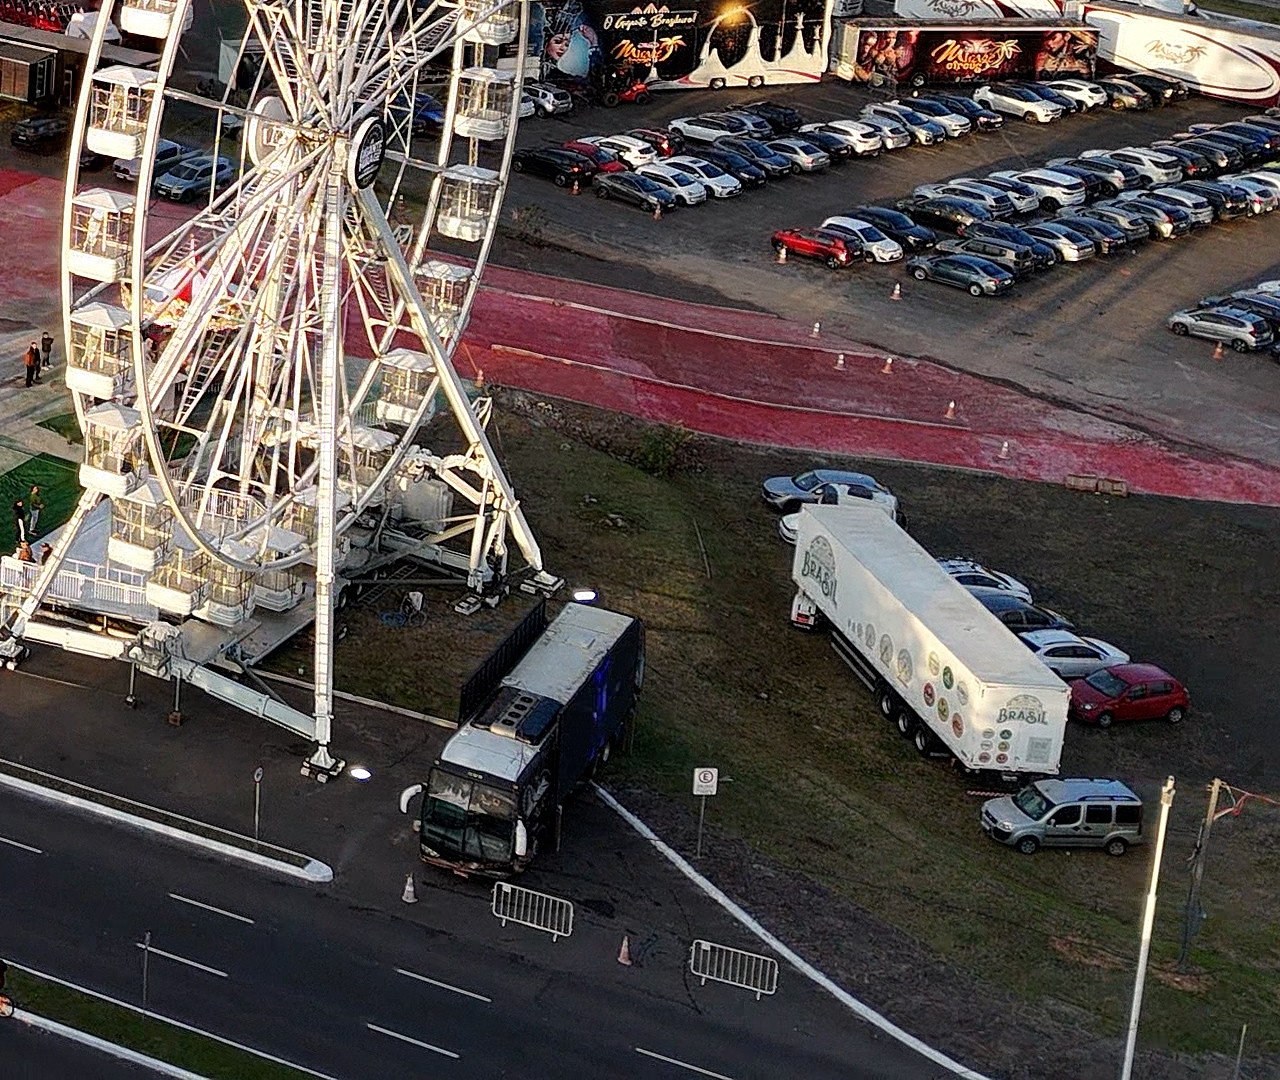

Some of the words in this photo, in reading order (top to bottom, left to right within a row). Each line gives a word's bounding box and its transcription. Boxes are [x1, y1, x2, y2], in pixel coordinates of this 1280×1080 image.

[930, 39, 998, 66] Mirage
[801, 551, 839, 608] BRASIL
[996, 708, 1049, 726] BRASIL
